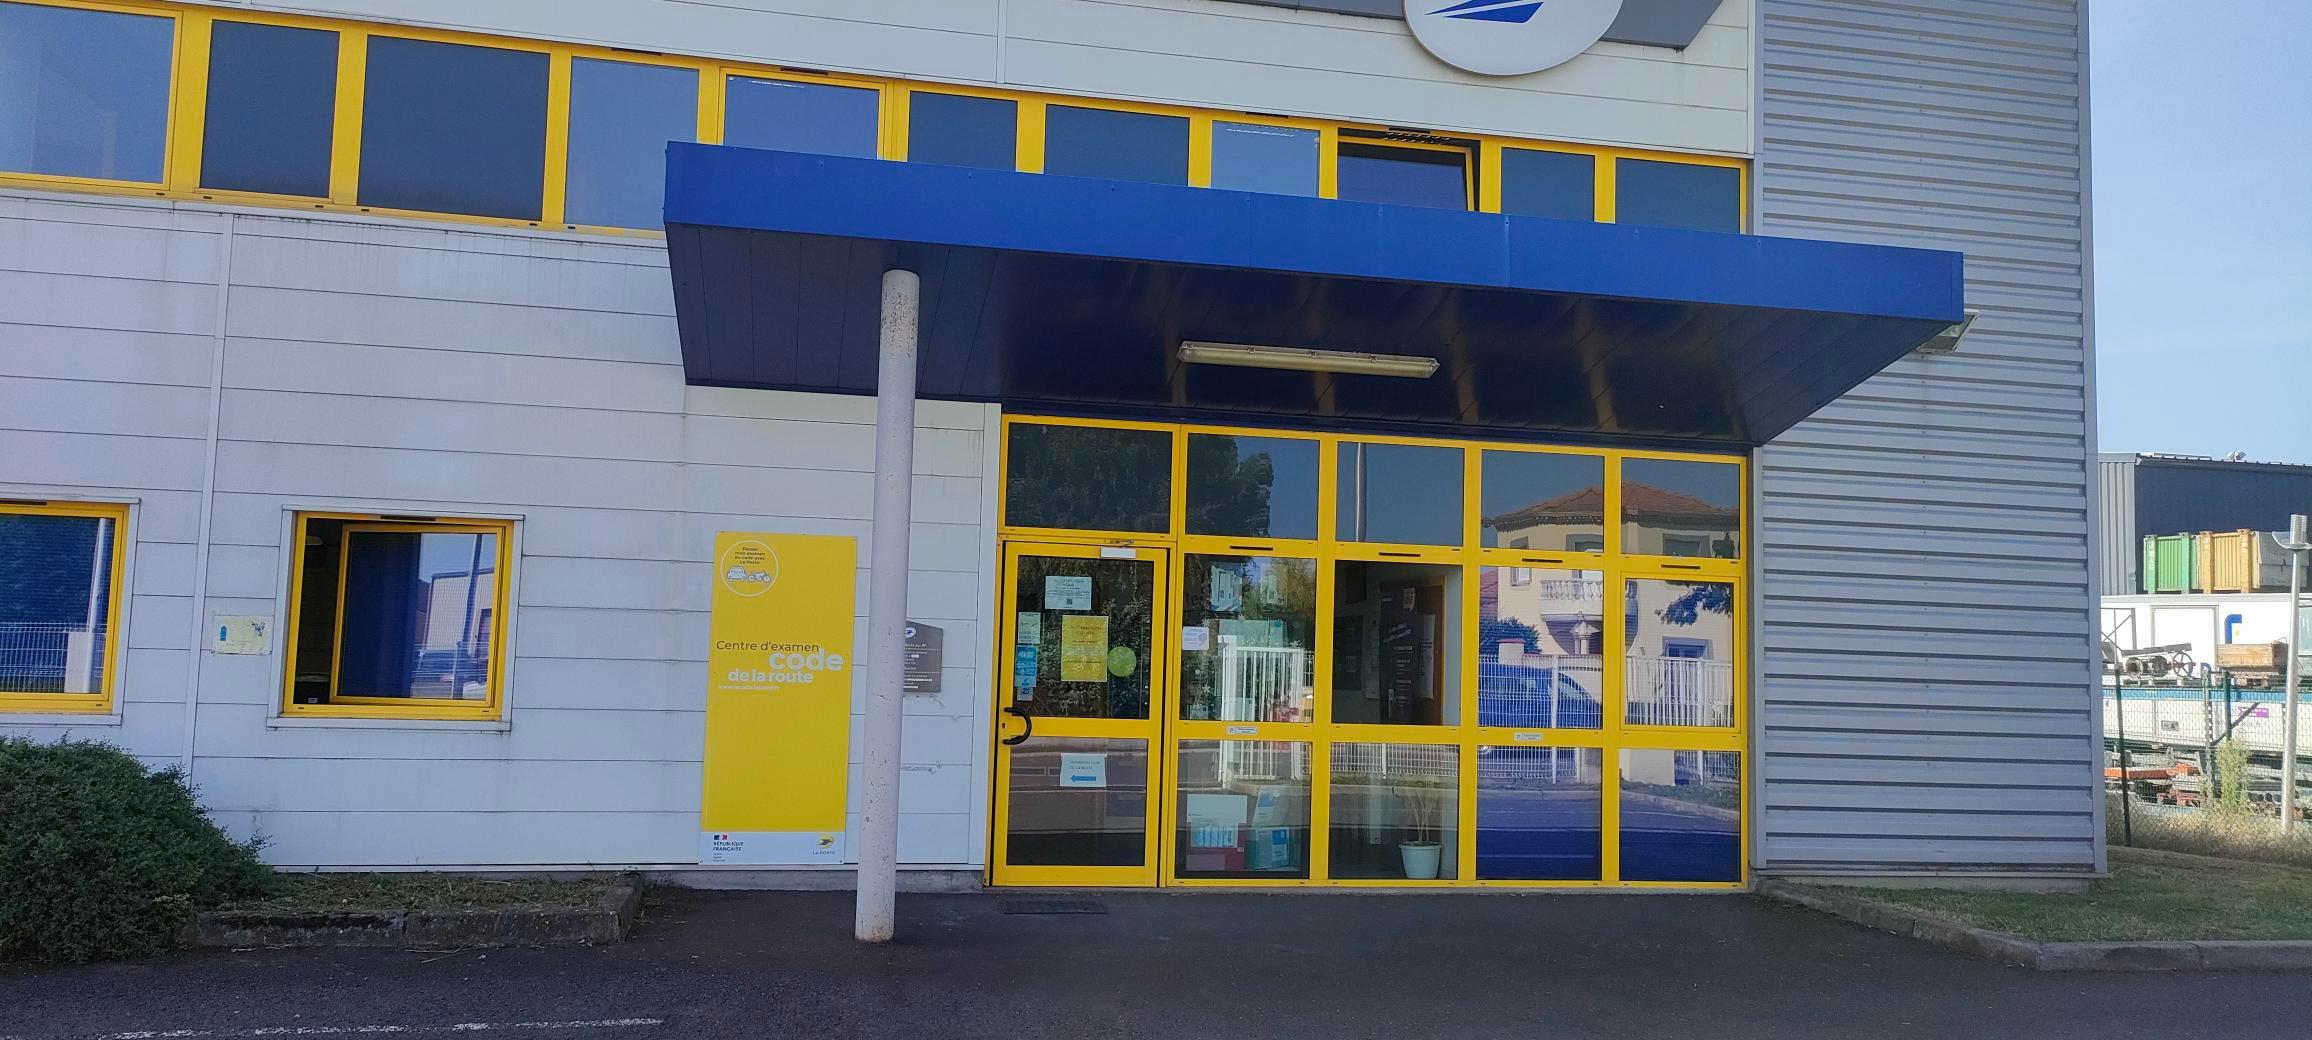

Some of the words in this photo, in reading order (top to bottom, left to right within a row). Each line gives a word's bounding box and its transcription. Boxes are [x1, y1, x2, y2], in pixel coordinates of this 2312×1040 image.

[716, 640, 757, 651] Centre
[760, 641, 819, 653] d'examen
[769, 648, 844, 672] code
[728, 668, 750, 682] de
[752, 668, 766, 683] la
[768, 671, 814, 684] route
